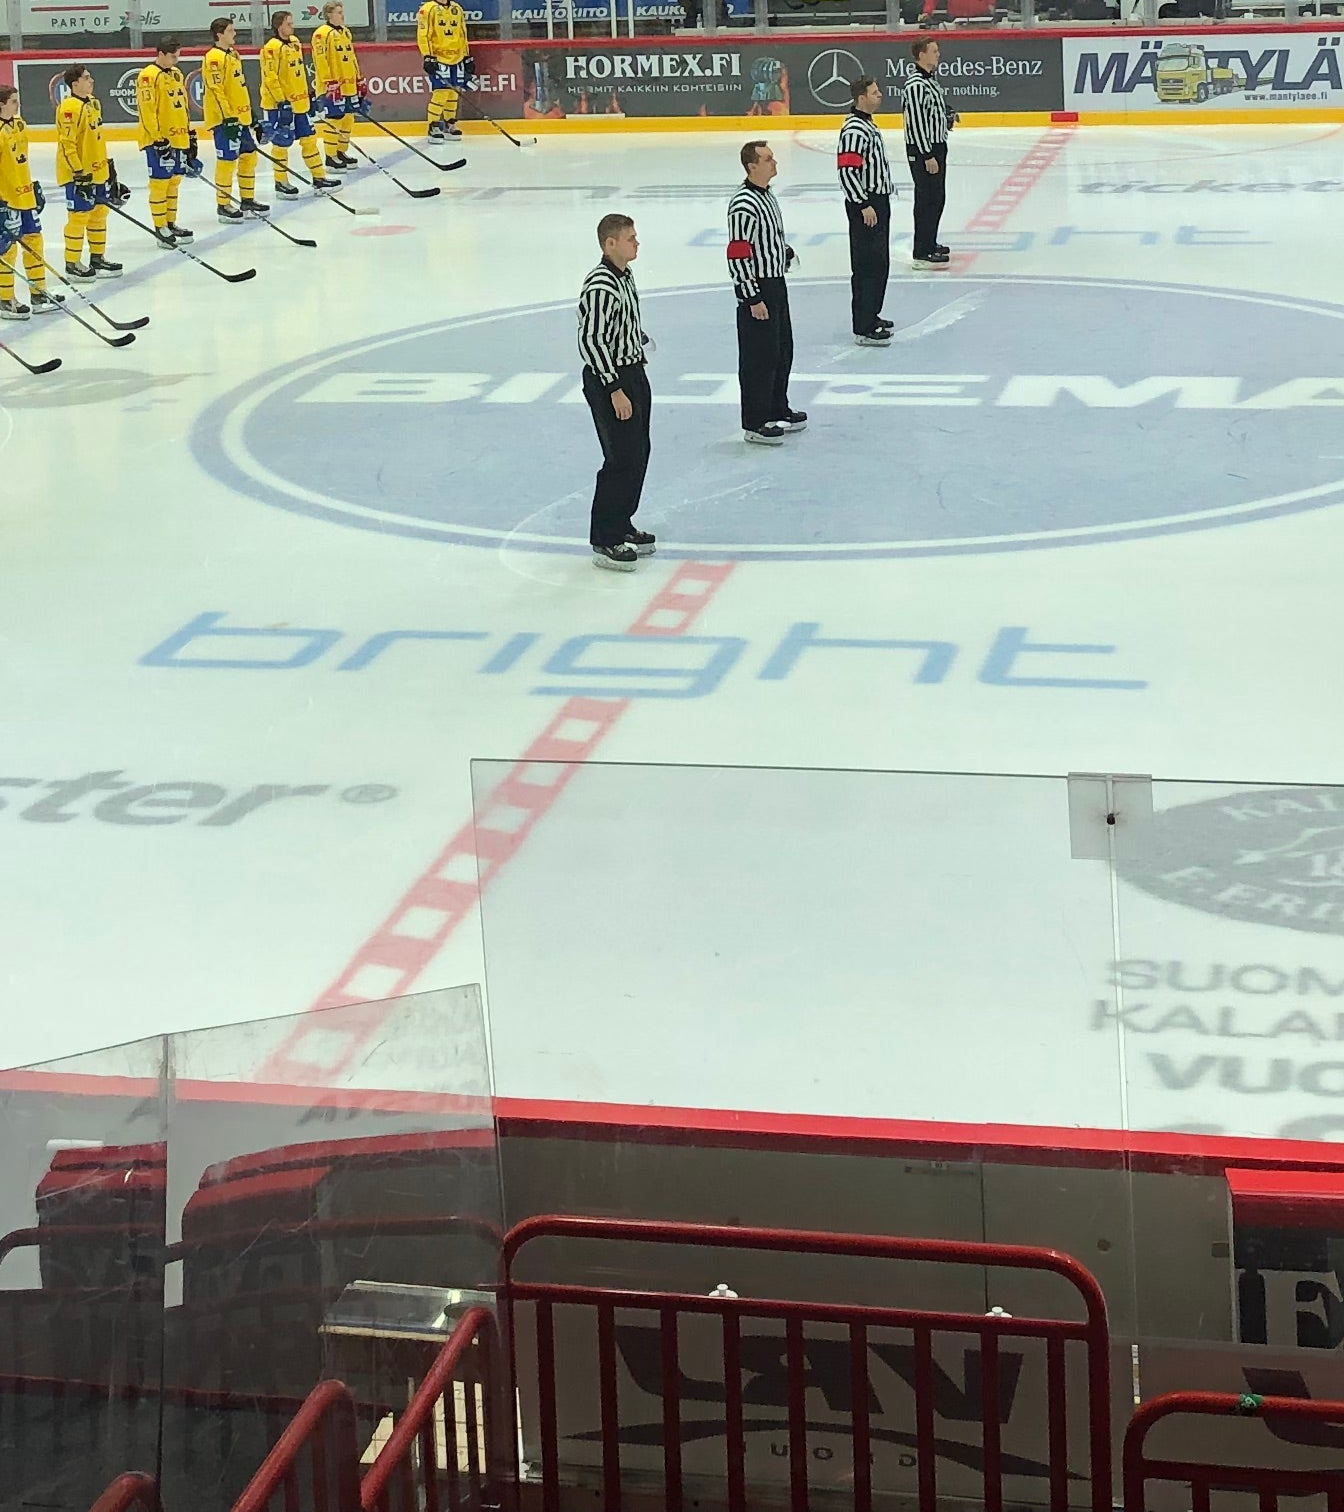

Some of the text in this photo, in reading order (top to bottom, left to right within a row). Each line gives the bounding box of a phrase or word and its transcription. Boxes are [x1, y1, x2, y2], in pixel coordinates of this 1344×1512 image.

[51, 17, 84, 29] PART
[94, 16, 111, 28] OF
[565, 52, 742, 80] HORMEX.FI
[886, 55, 1043, 80] Meedes-Benz
[364, 72, 518, 95] OCKEYSE.FI
[952, 84, 1002, 99] nothing.
[138, 611, 1150, 699] bright
